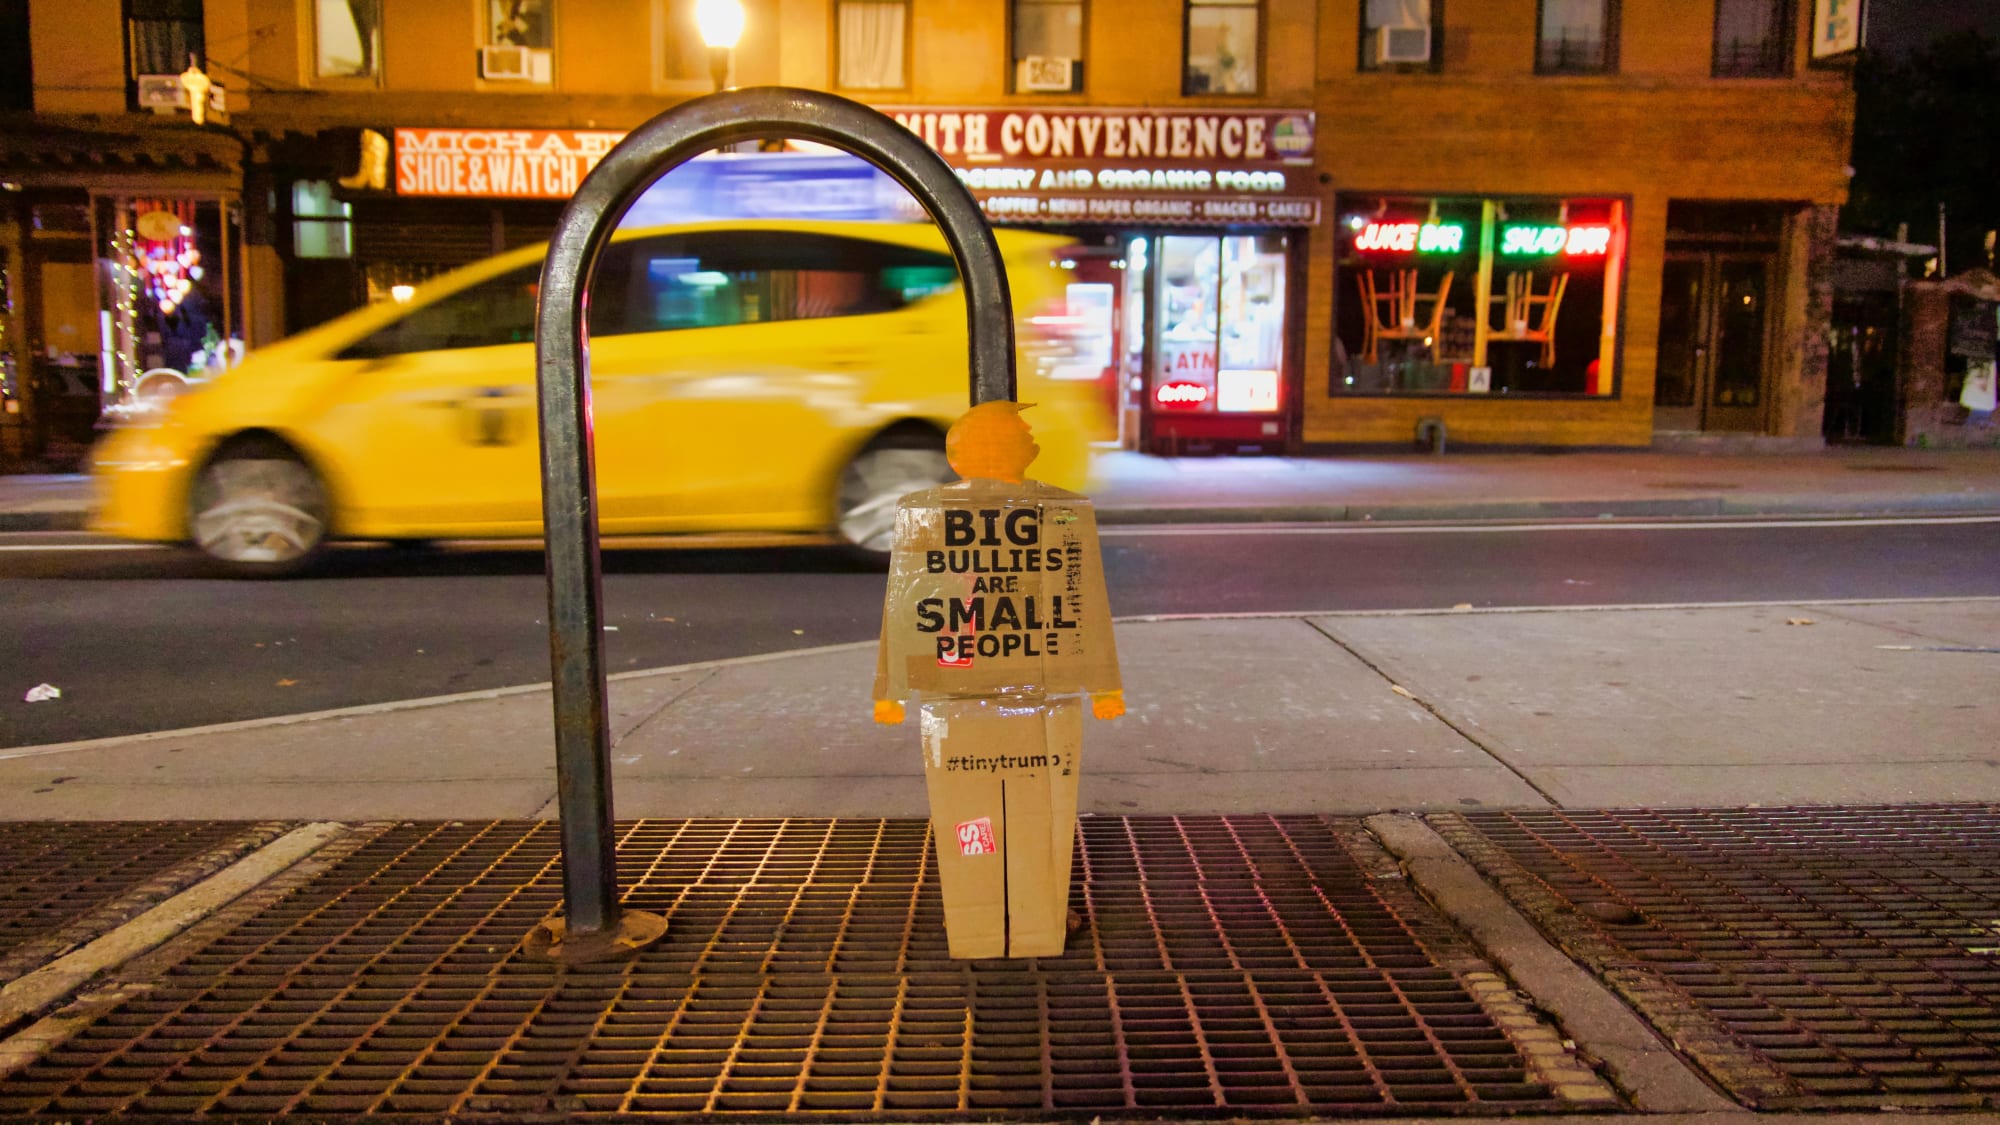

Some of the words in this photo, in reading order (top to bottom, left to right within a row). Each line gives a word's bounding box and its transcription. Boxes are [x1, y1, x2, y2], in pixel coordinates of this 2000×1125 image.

[1001, 114, 1266, 158] CONVENIENCE
[400, 153, 578, 195] SHOE&WATCH
[1039, 170, 1094, 190] AND
[1097, 169, 1212, 191] ORGANIC
[1215, 170, 1286, 192] FOOD
[986, 196, 1039, 214] COFFEE
[1089, 199, 1131, 215] PAPER
[1133, 200, 1193, 216] ORGANIC
[1203, 201, 1257, 217] SNACKS
[1267, 202, 1312, 217] CAKES
[1355, 223, 1420, 252] JUICE
[1420, 223, 1464, 254] BAR
[1502, 226, 1568, 255] SALAD
[1566, 226, 1611, 255] BAR
[944, 508, 1039, 547] BIG
[926, 547, 1064, 574] BULLIES
[972, 575, 1019, 594] ARE
[916, 595, 1077, 633] SMALL
[936, 632, 1060, 659] PEOPLE
